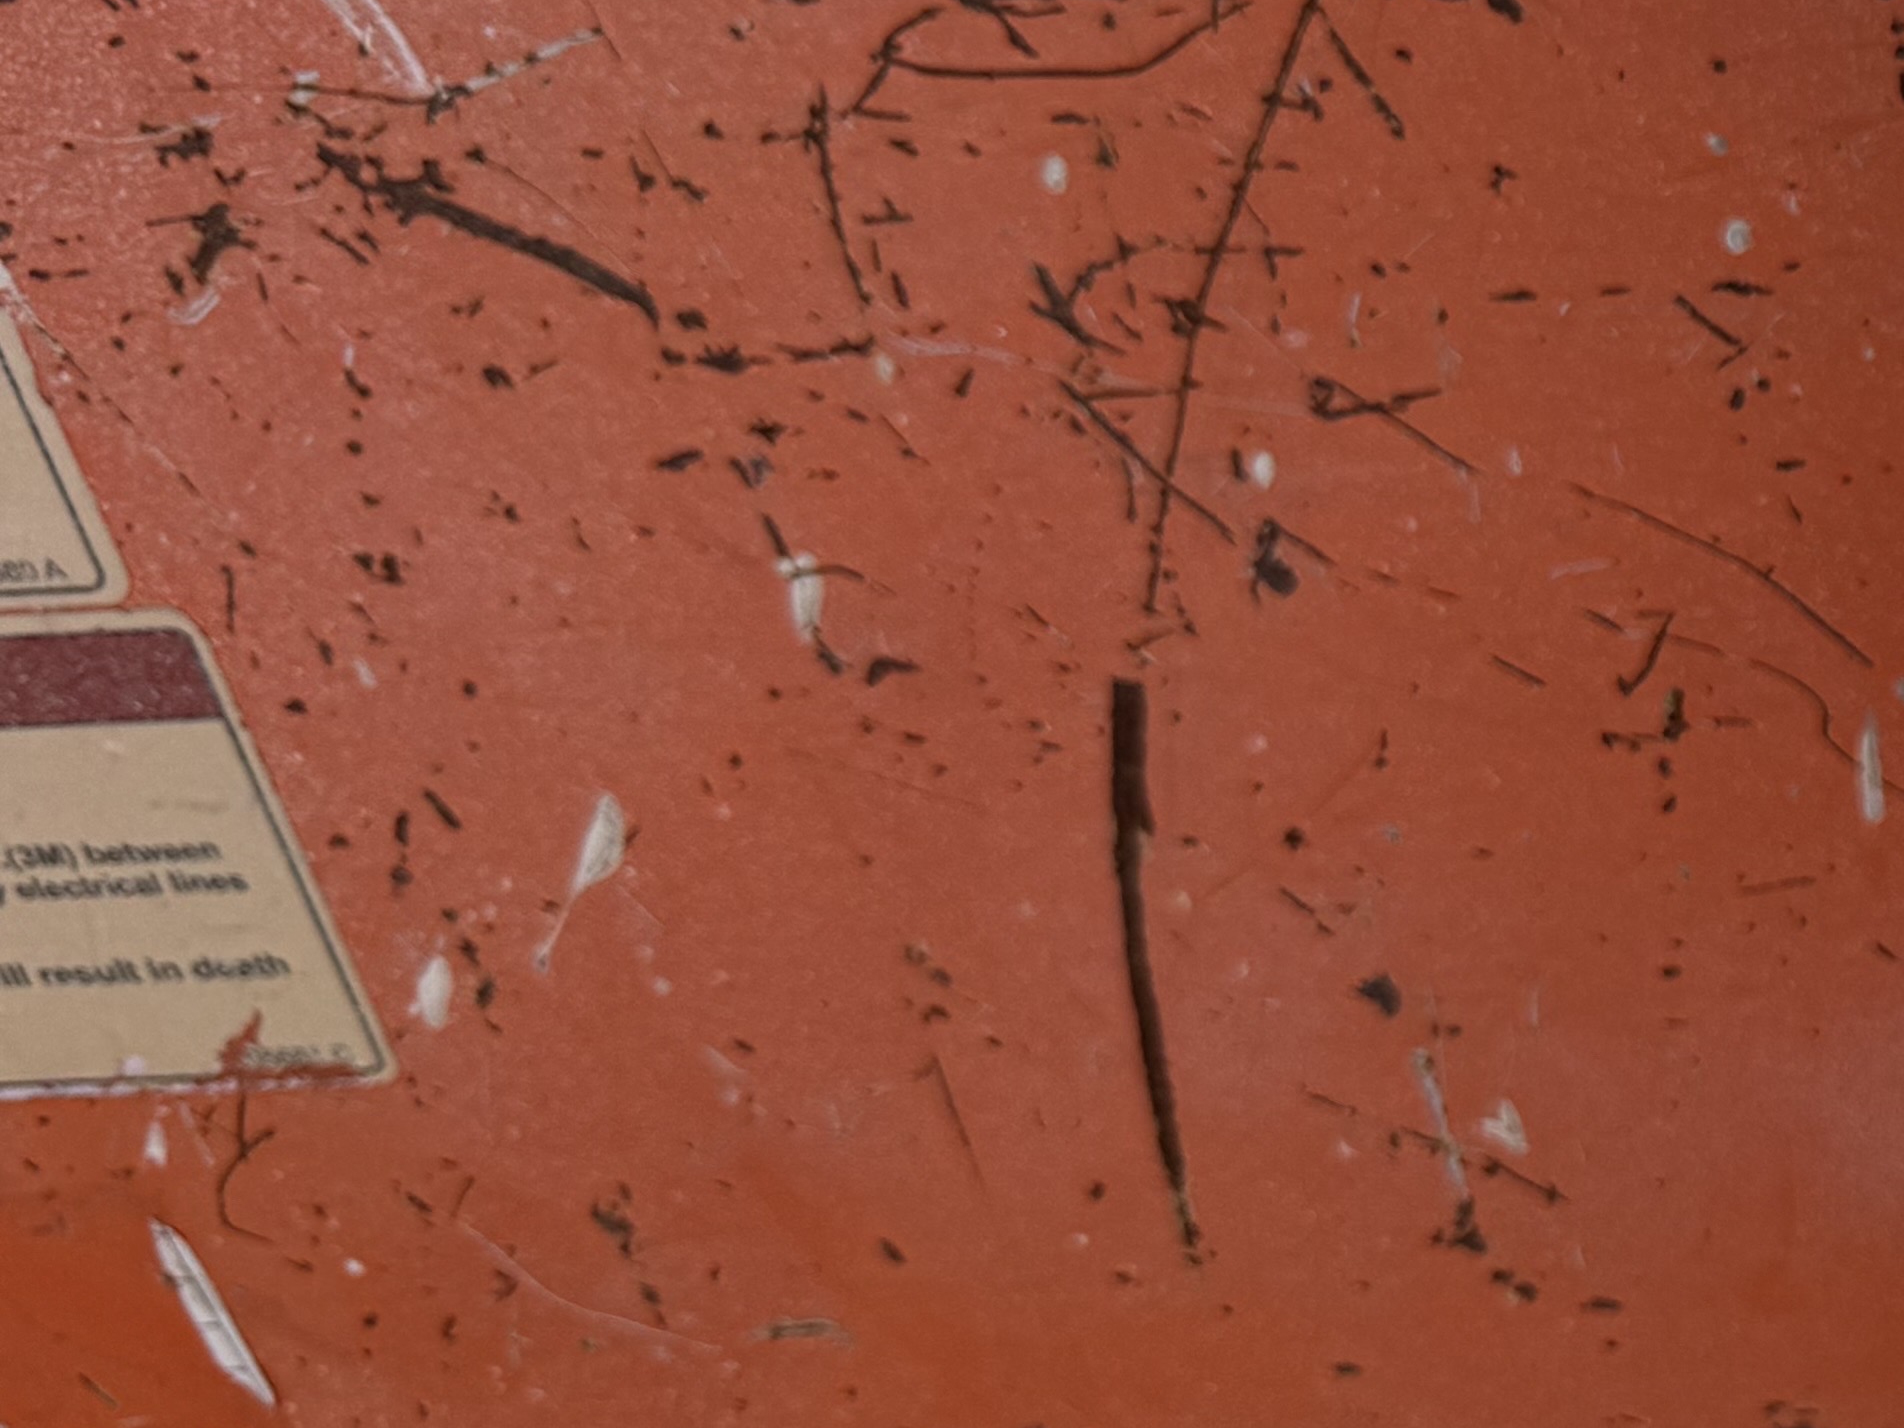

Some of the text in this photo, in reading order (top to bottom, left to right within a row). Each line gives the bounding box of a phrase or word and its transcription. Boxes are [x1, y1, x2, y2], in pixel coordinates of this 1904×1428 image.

[44, 555, 70, 581] A
[82, 841, 221, 865] between
[15, 871, 163, 900] electrical
[167, 871, 248, 894] lines
[38, 957, 143, 986] result
[146, 957, 184, 981] in
[190, 950, 292, 982] death
